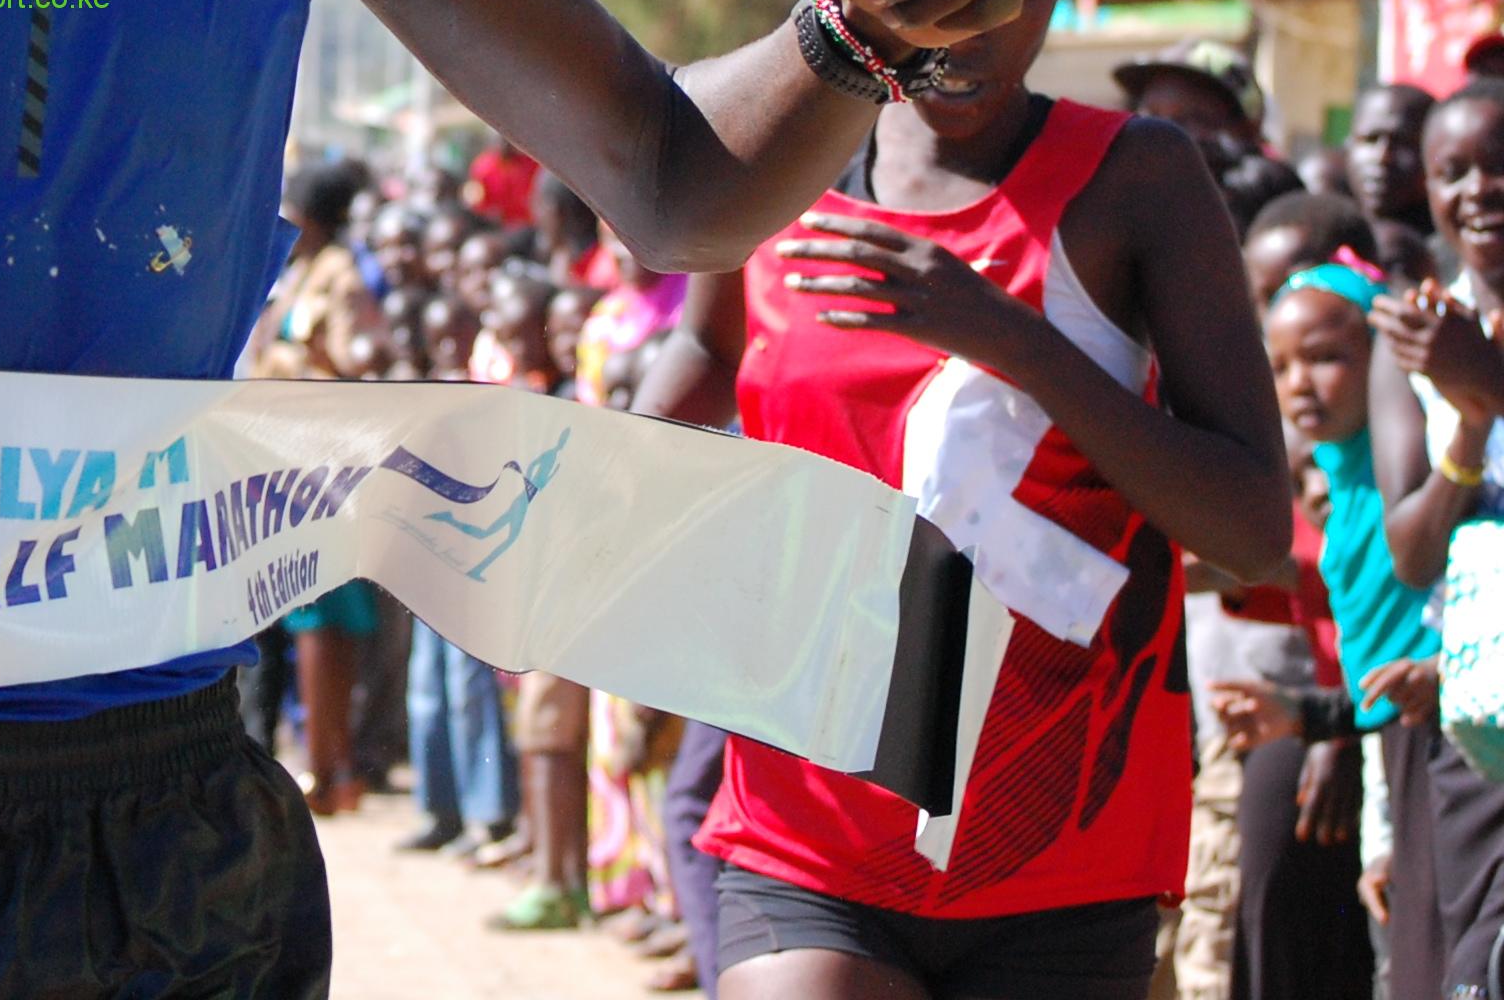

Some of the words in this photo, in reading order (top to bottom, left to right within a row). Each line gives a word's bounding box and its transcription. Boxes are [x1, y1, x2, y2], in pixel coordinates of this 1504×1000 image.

[104, 464, 374, 590] MARATHON
[247, 569, 273, 626] 4th
[268, 548, 319, 610] Edition
